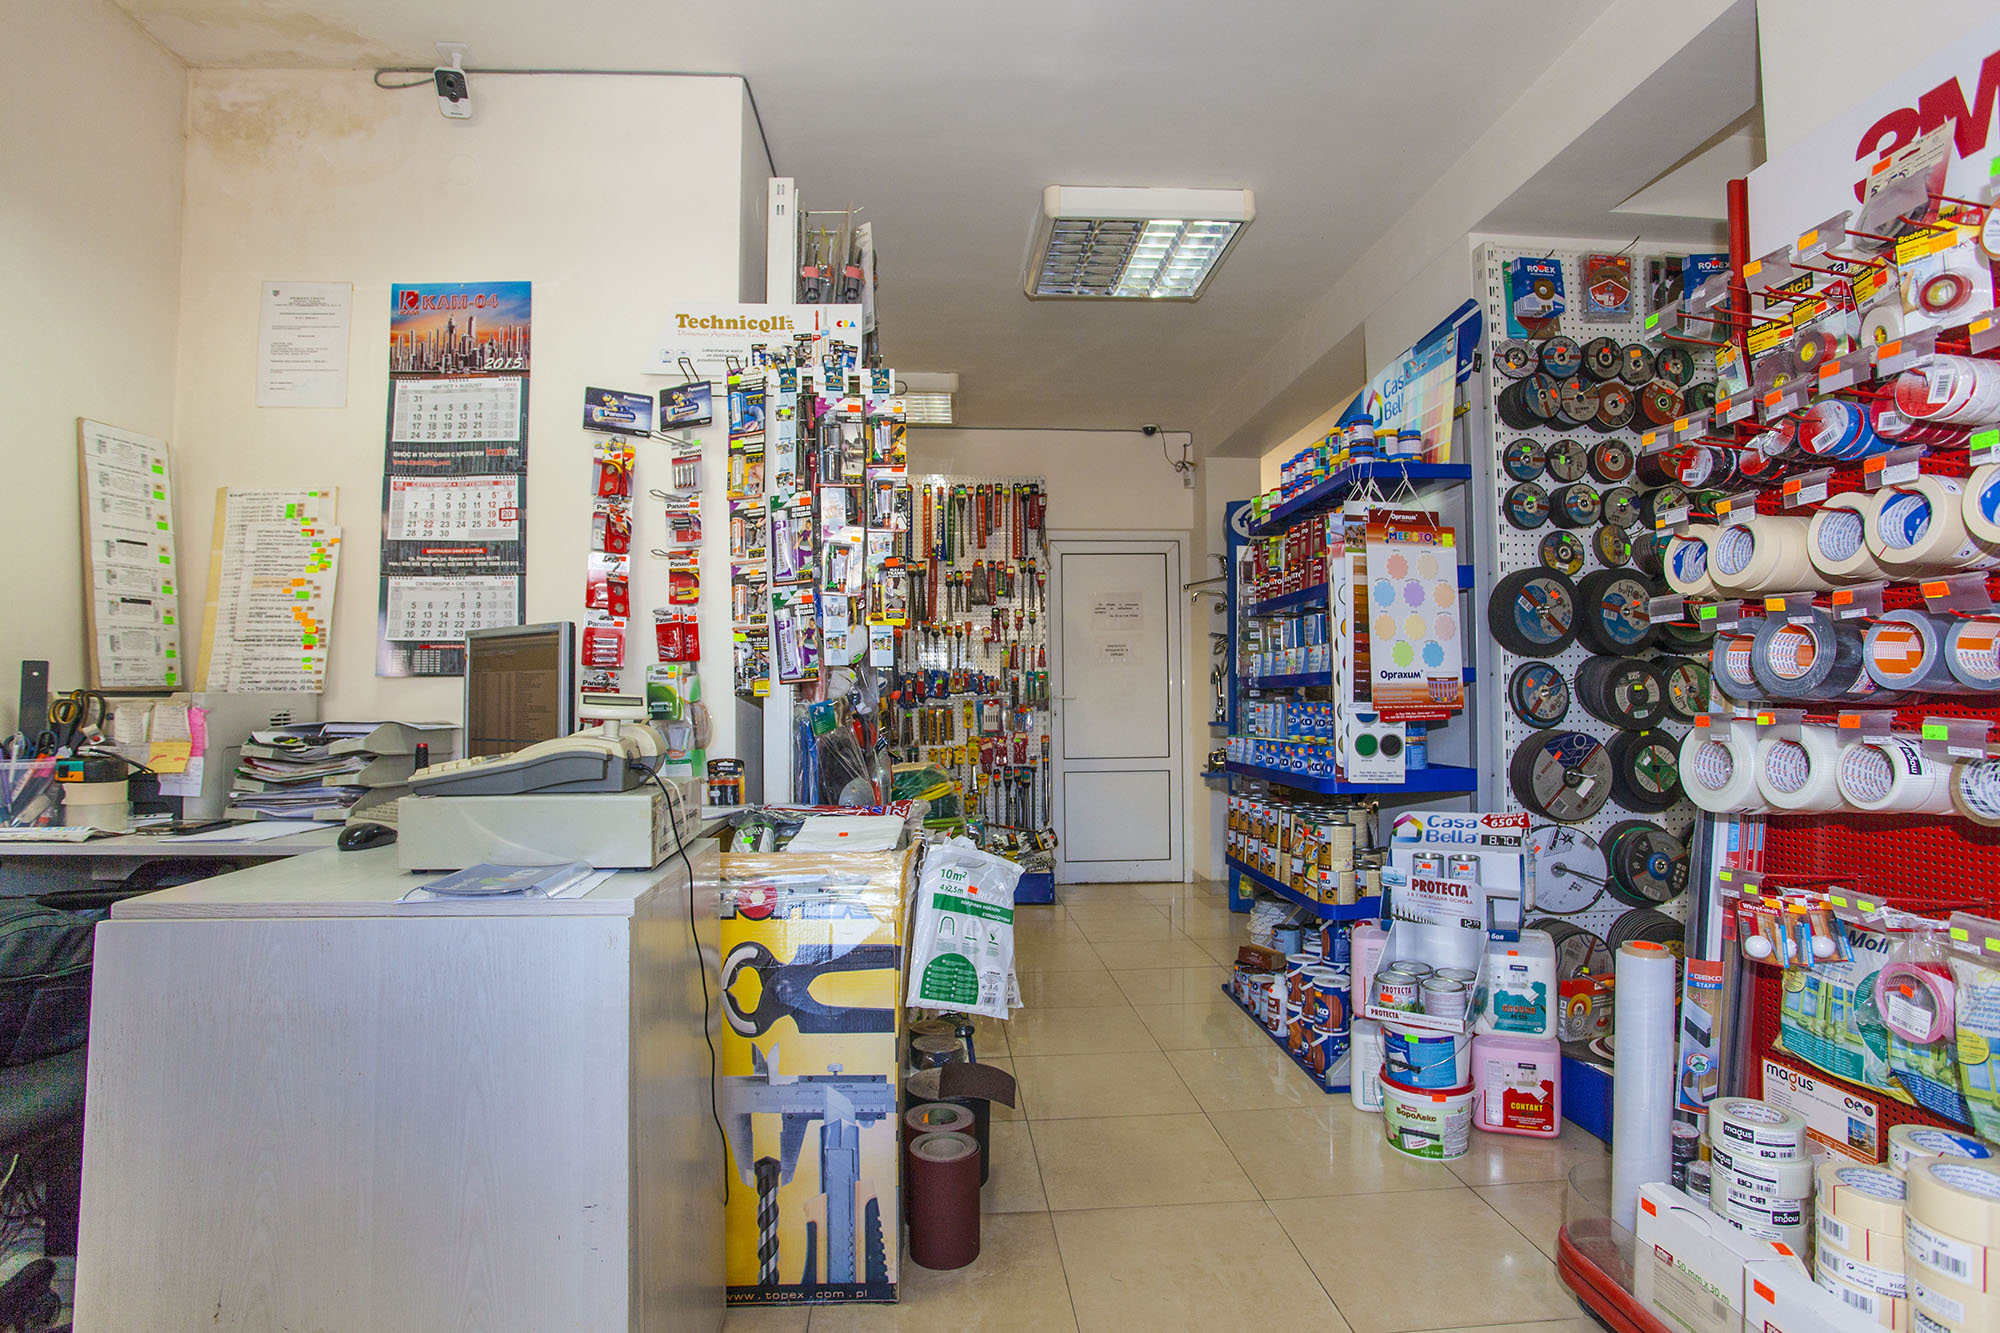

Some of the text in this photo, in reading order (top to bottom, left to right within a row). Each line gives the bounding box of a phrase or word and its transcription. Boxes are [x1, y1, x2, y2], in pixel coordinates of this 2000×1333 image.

[1897, 228, 1930, 243] Scotch
[1853, 268, 1872, 284] Scotch
[676, 313, 786, 332] Technicqll
[1747, 323, 1772, 337] Scotch
[484, 358, 523, 370] 2015
[604, 410, 634, 419] Panasonic
[674, 404, 698, 414] Panasonic
[1388, 531, 1432, 542] MEFISTO
[1427, 815, 1477, 828] Casa
[1426, 830, 1477, 844] Bella
[1412, 878, 1468, 898] PROTECTA
[1382, 985, 1412, 994] PROTECTA
[1371, 1009, 1399, 1019] PROTECTA
[1502, 1004, 1535, 1014] GROUND
[1766, 1063, 1814, 1092] magus
[1510, 1102, 1543, 1112] CONTAKT
[1724, 1124, 1752, 1139] magus
[1677, 1259, 1686, 1272] 50
[1688, 1269, 1702, 1283] mm
[1710, 1284, 1720, 1298] 30
[1722, 1294, 1730, 1305] m
